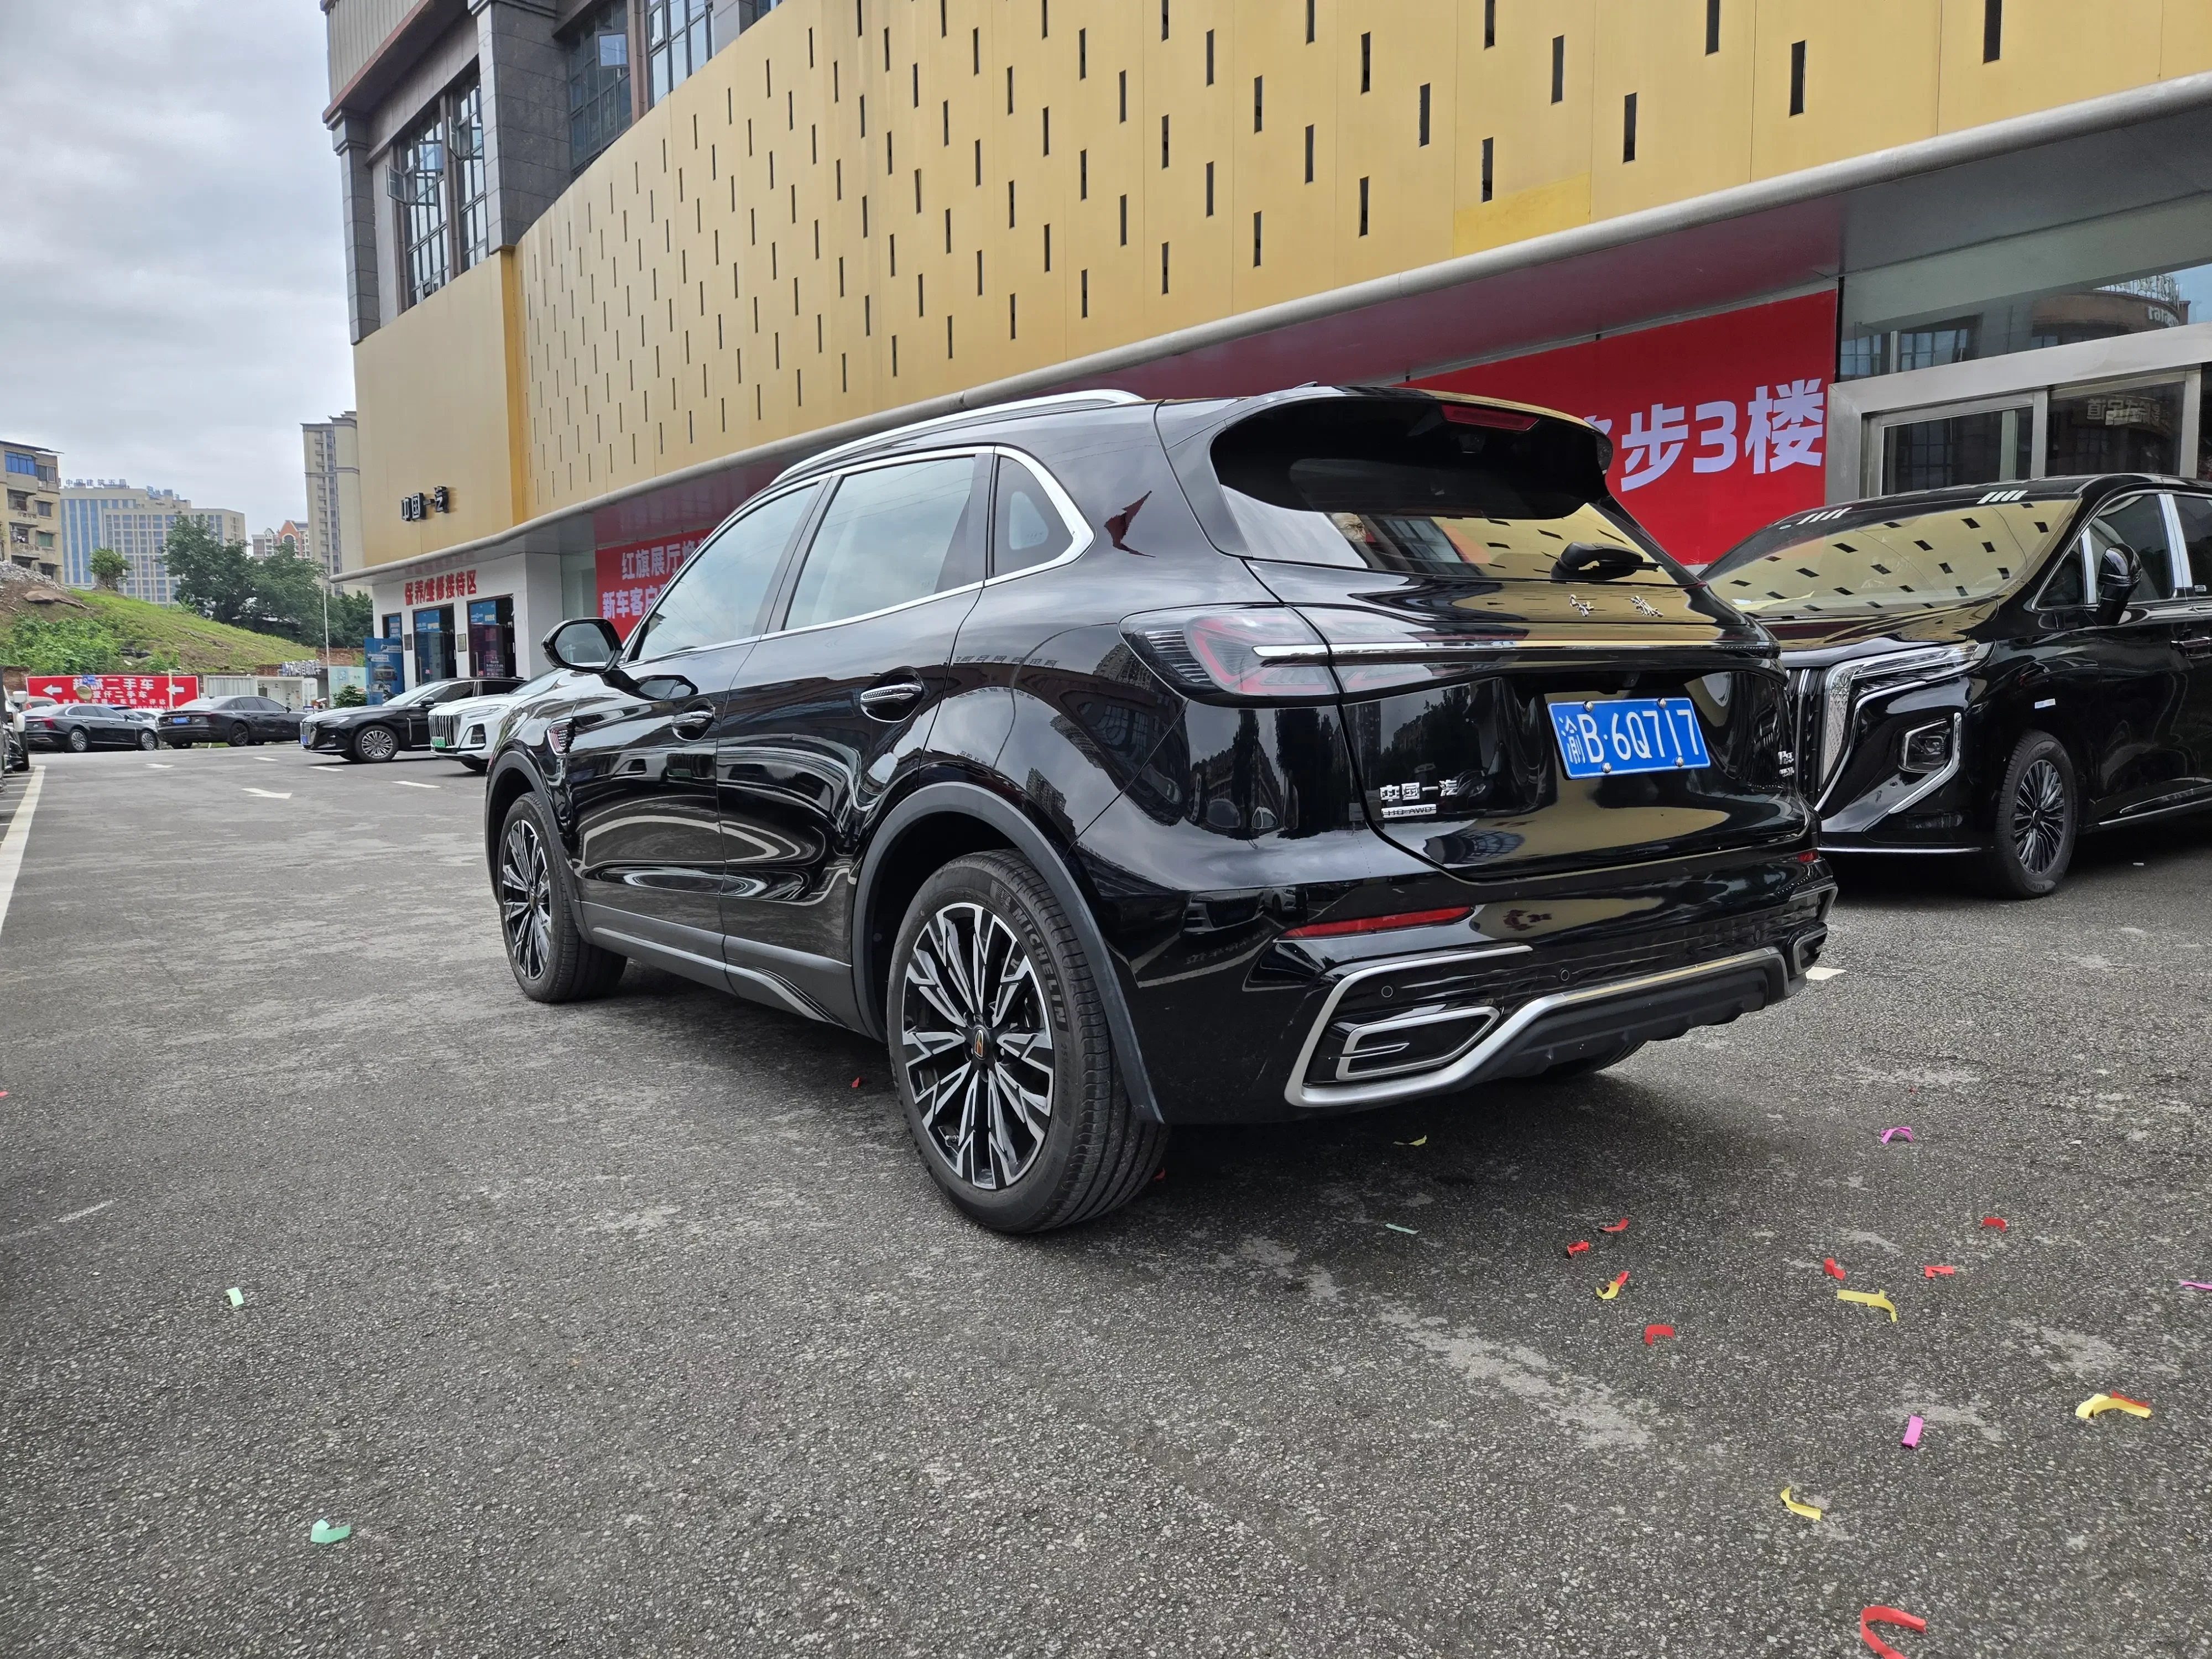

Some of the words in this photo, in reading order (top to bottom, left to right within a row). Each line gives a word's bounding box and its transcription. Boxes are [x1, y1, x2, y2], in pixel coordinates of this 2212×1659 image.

[1584, 378, 1824, 492] 步3楼
[404, 570, 476, 606] 保养/维修接待区
[603, 583, 667, 619] 新车客户
[1380, 779, 1458, 802] 中国一汽
[1013, 907, 1066, 1022] MICHELIN
